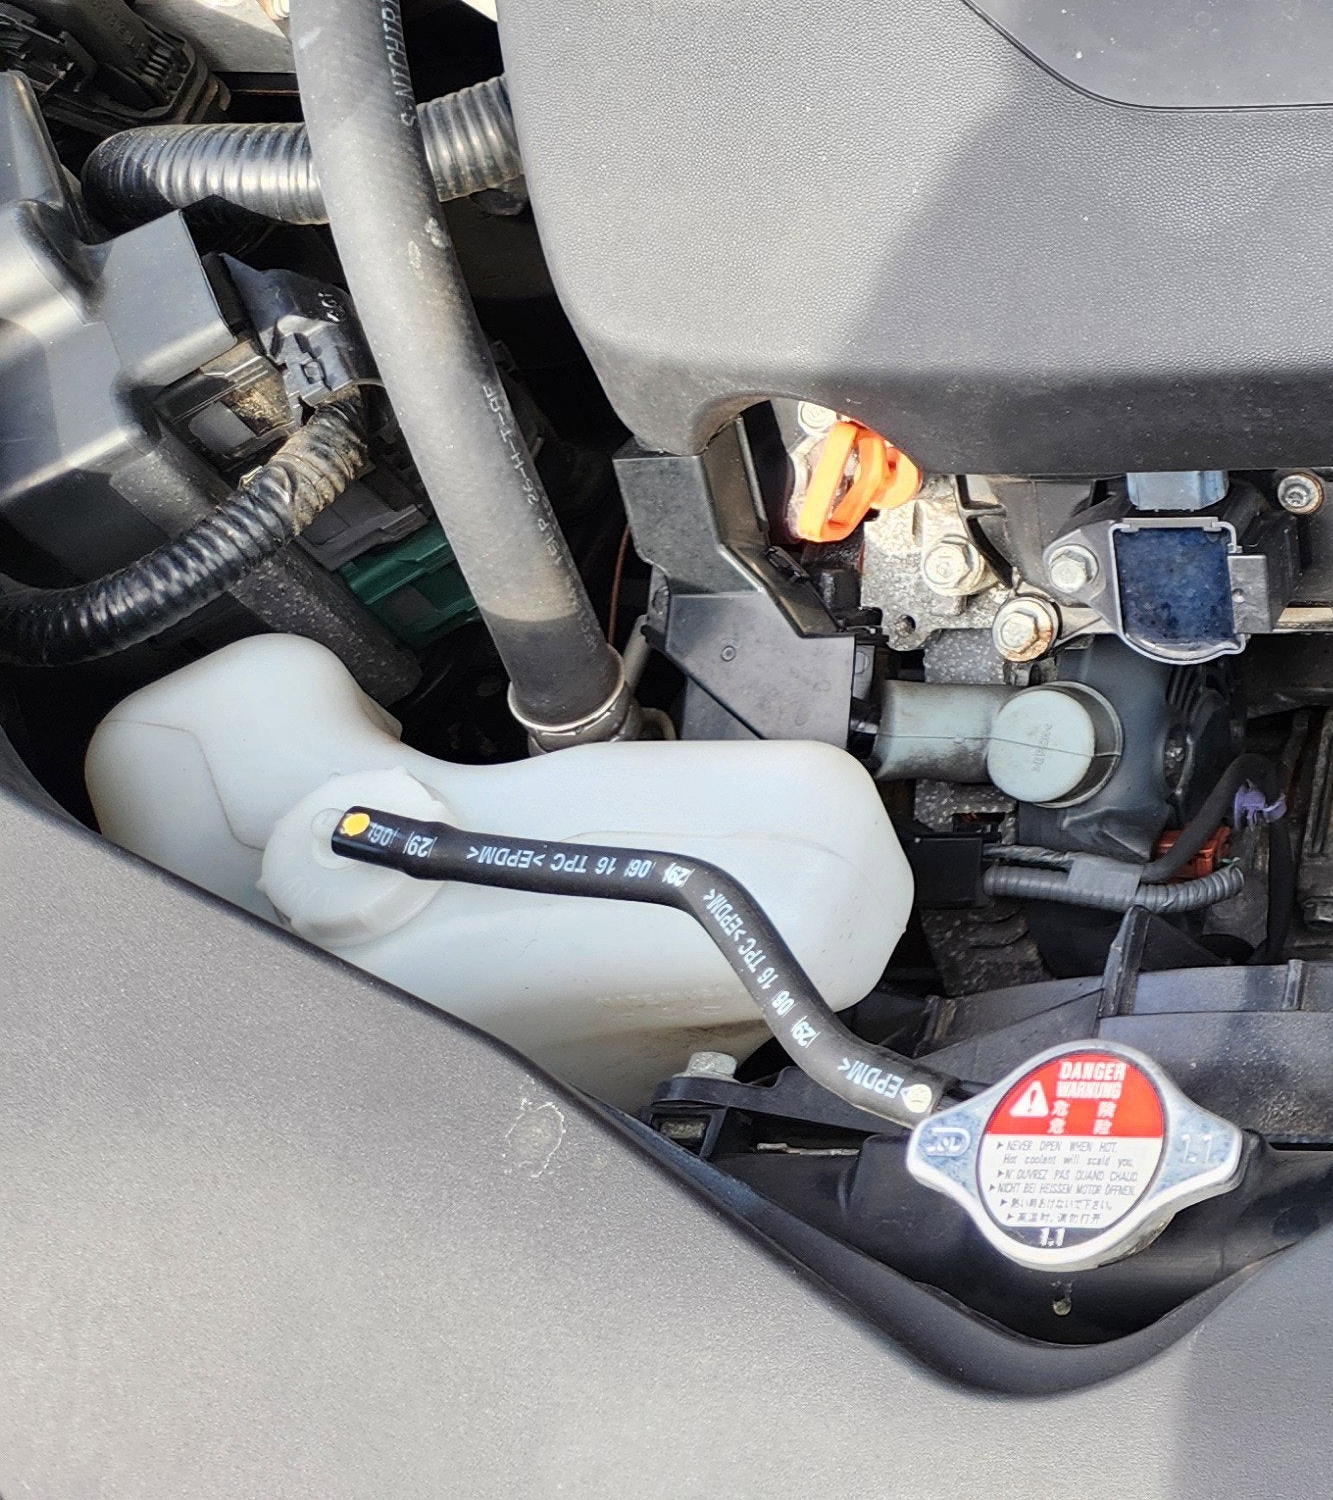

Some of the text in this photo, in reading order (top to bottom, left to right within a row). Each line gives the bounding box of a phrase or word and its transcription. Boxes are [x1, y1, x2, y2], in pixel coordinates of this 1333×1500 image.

[466, 845, 544, 869] >EPDM<
[551, 854, 588, 874] TPC
[595, 857, 618, 875] 16
[737, 936, 769, 973] TPC
[1058, 1060, 1126, 1082] DANGER
[1055, 1081, 1122, 1101] WARNUNG
[1006, 1140, 1119, 1153] NEVER OPEN WHEN HOT.
[1181, 1133, 1213, 1164] 1.1
[1002, 1154, 1019, 1166] Hot
[1024, 1154, 1058, 1167] coolant
[1062, 1154, 1081, 1167] will
[1086, 1154, 1112, 1168] scald
[1016, 1169, 1049, 1181] OUVREZ
[1053, 1170, 1072, 1181] PAS
[997, 1182, 1023, 1194] NICHT
[1076, 1183, 1104, 1195] MOTOR
[1039, 1227, 1065, 1247] 1.1
